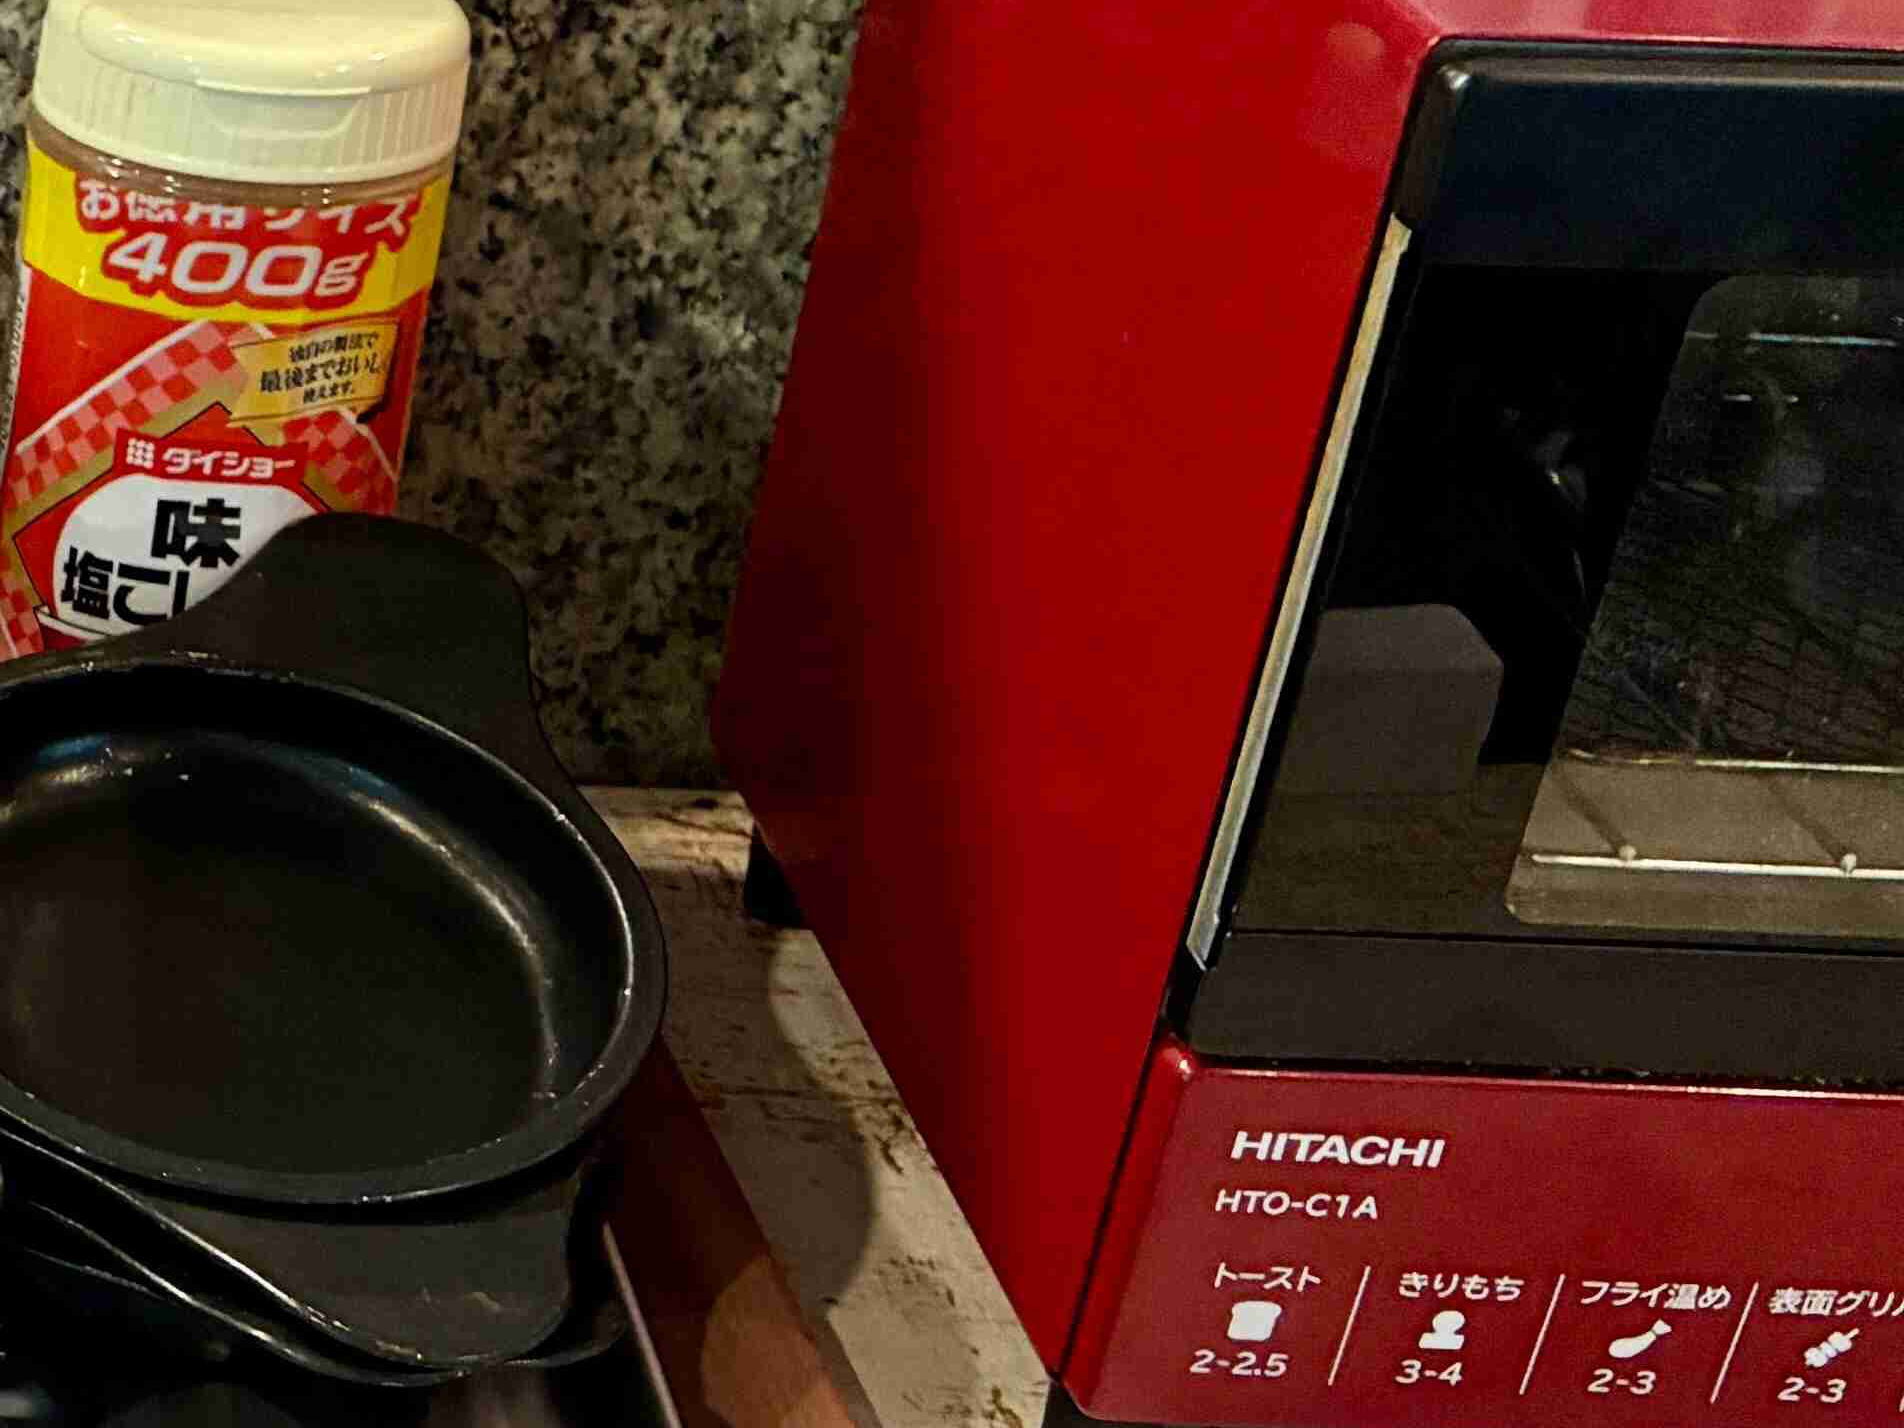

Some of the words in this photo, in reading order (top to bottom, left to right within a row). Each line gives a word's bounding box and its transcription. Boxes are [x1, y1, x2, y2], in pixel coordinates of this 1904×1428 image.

[107, 232, 370, 298] 400g
[162, 447, 296, 479] ダイショー
[150, 497, 242, 568] 味
[1230, 1130, 1445, 1169] HITACHI
[1214, 1189, 1380, 1220] HTO-C1A
[1212, 1261, 1322, 1294] トースト
[1398, 1271, 1526, 1303] きりもち
[1579, 1280, 1732, 1311] フライ温め
[1189, 1350, 1289, 1378] 2-2.5
[1395, 1360, 1463, 1387] 3-4
[1587, 1368, 1656, 1396] 2-3
[1777, 1376, 1848, 1404] 2-3
